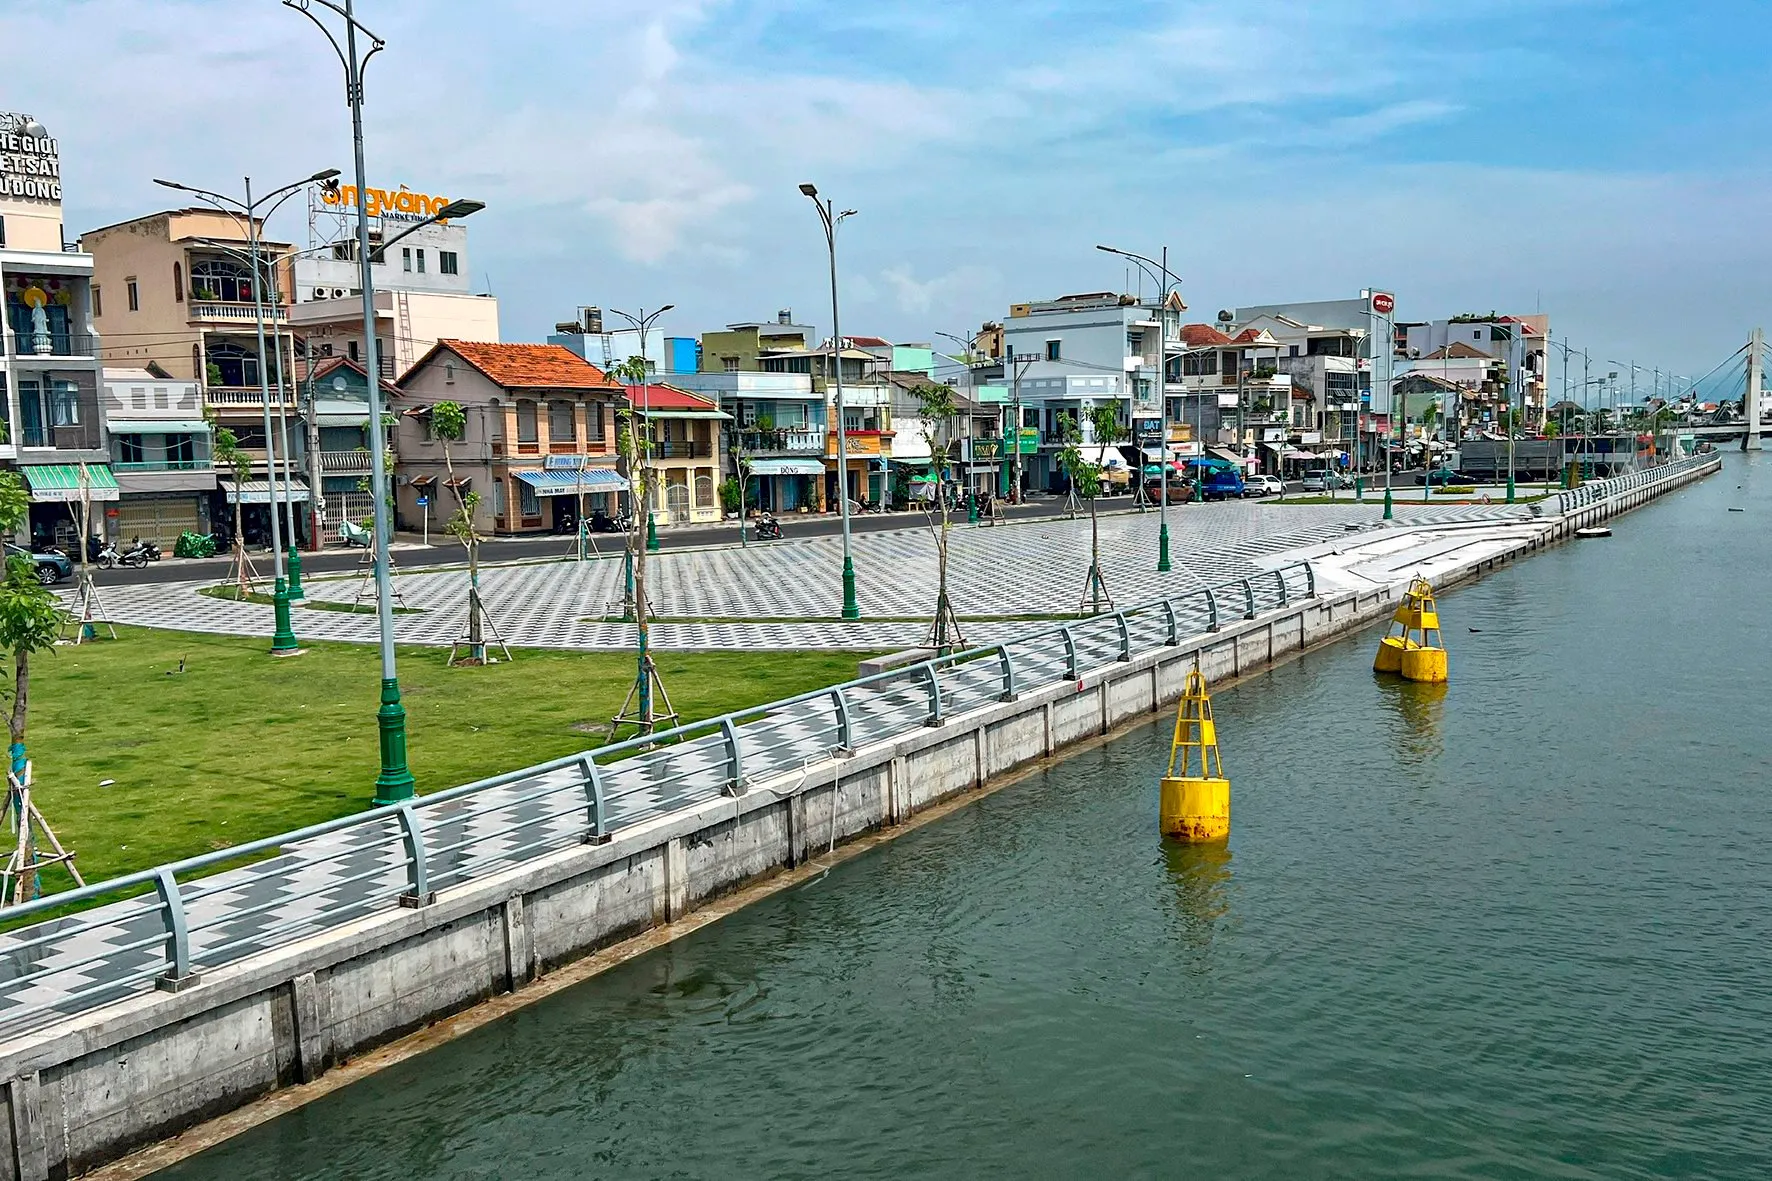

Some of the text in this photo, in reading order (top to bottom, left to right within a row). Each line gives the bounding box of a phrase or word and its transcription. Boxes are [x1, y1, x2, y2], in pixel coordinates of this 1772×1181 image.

[22, 134, 57, 155] GIỚI
[26, 153, 59, 177] SẮT
[12, 177, 62, 200] ĐÔNG
